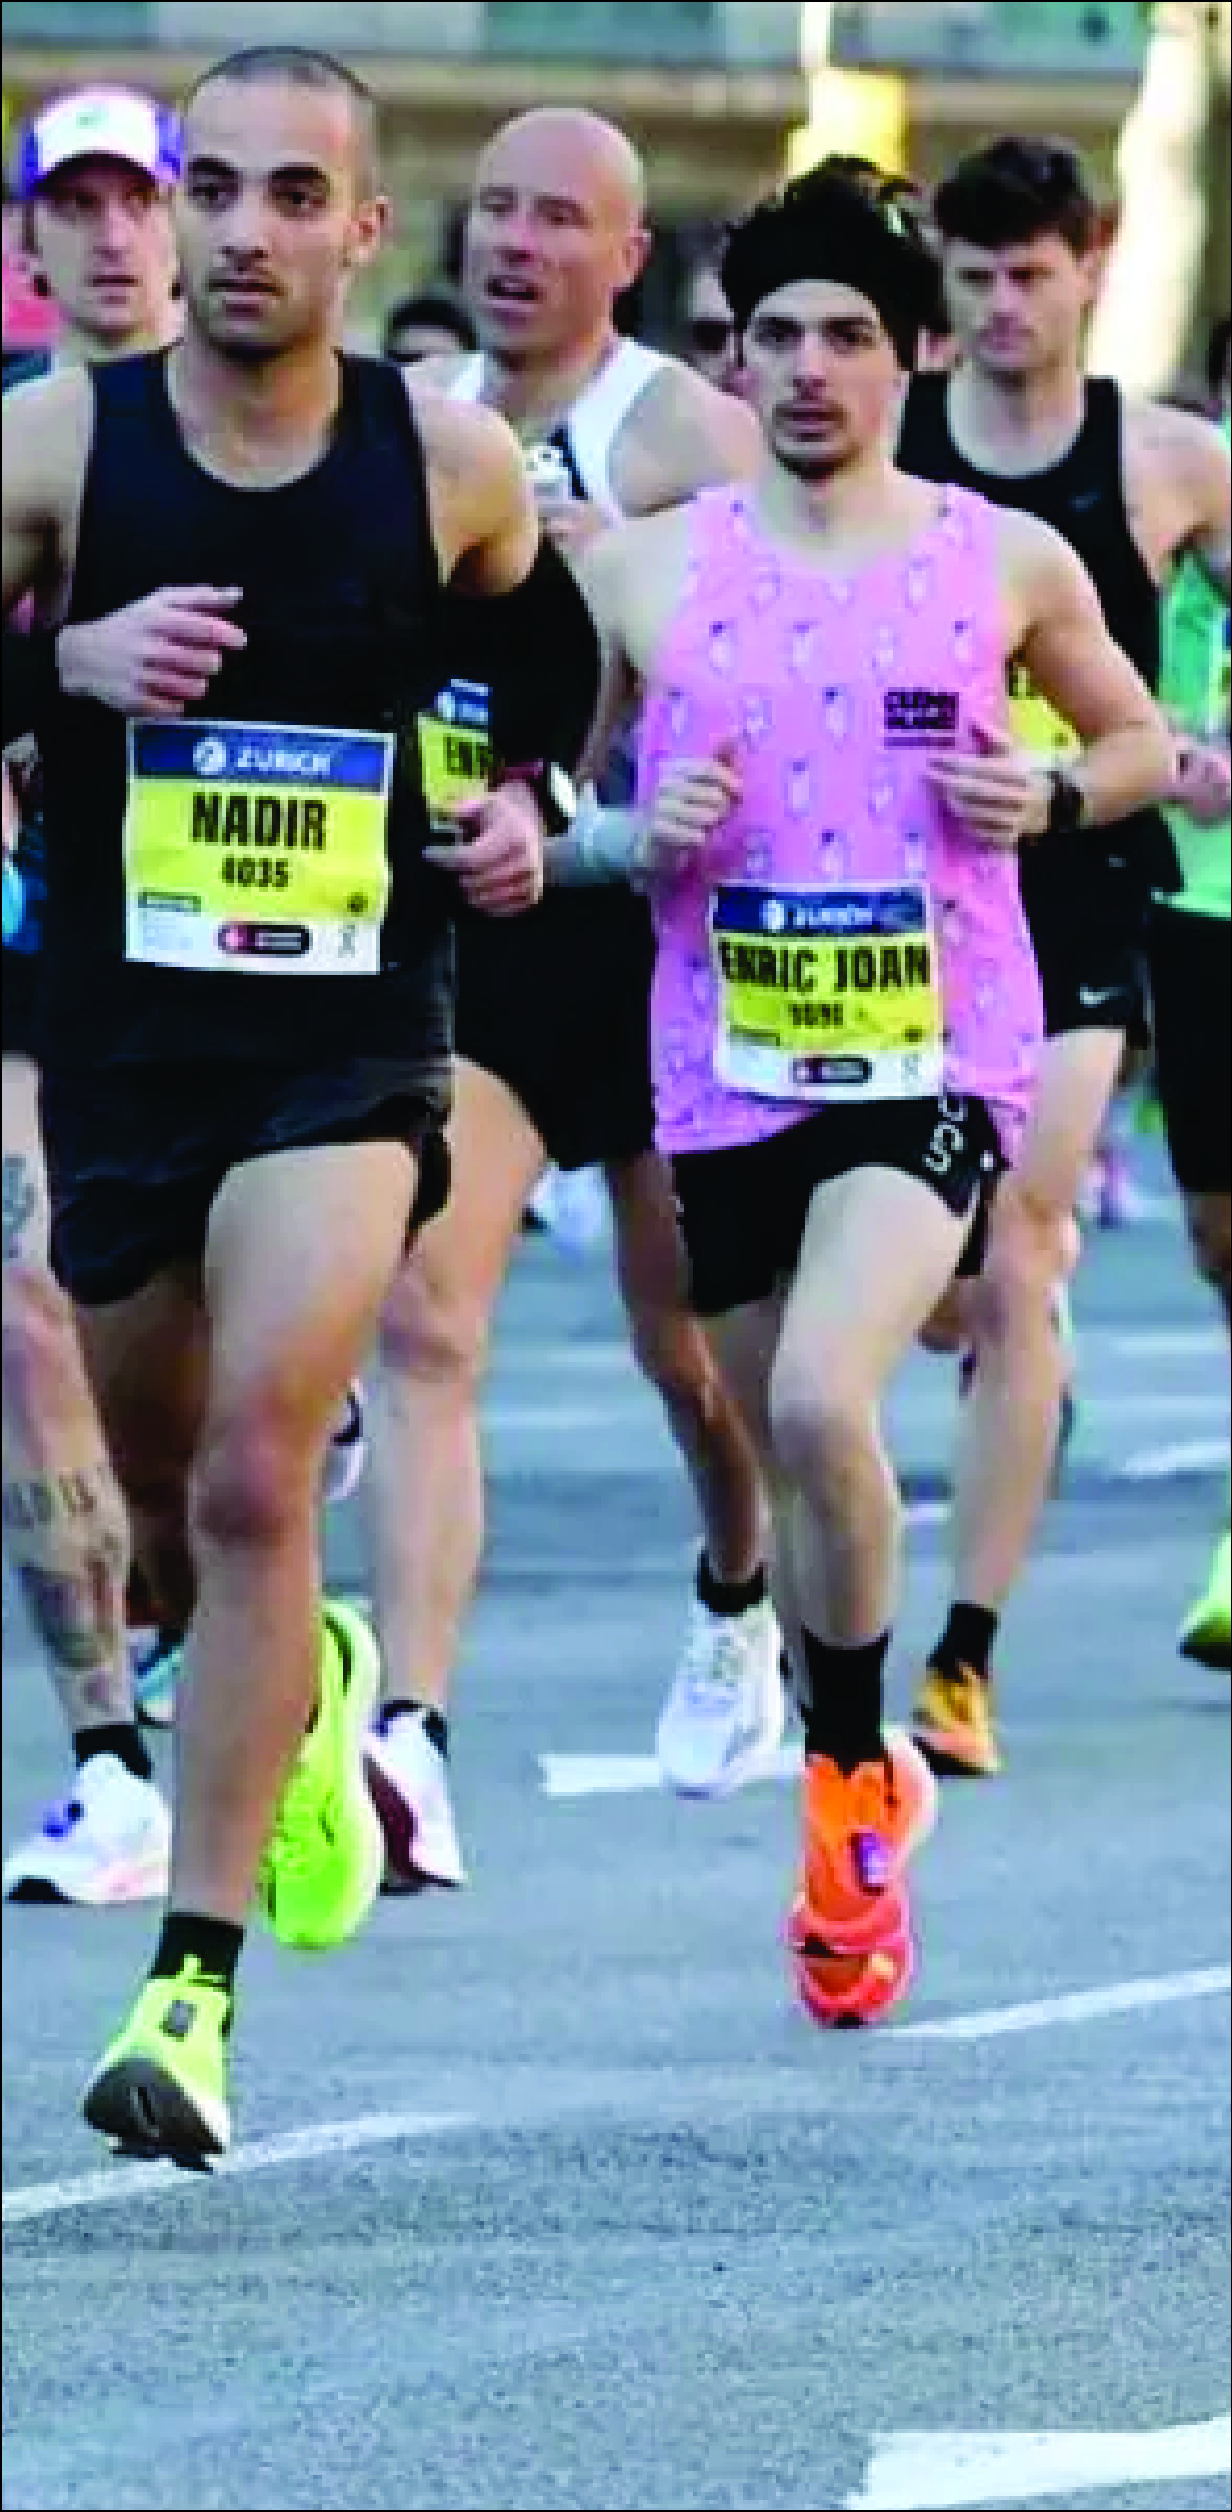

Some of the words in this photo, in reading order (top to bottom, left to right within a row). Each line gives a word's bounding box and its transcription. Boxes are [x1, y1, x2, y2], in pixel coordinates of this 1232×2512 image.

[234, 746, 331, 776] ZURICH
[191, 791, 326, 851] NADIR
[221, 855, 290, 889] 4035
[719, 940, 818, 994] ENRIC
[834, 944, 930, 992] JOAN
